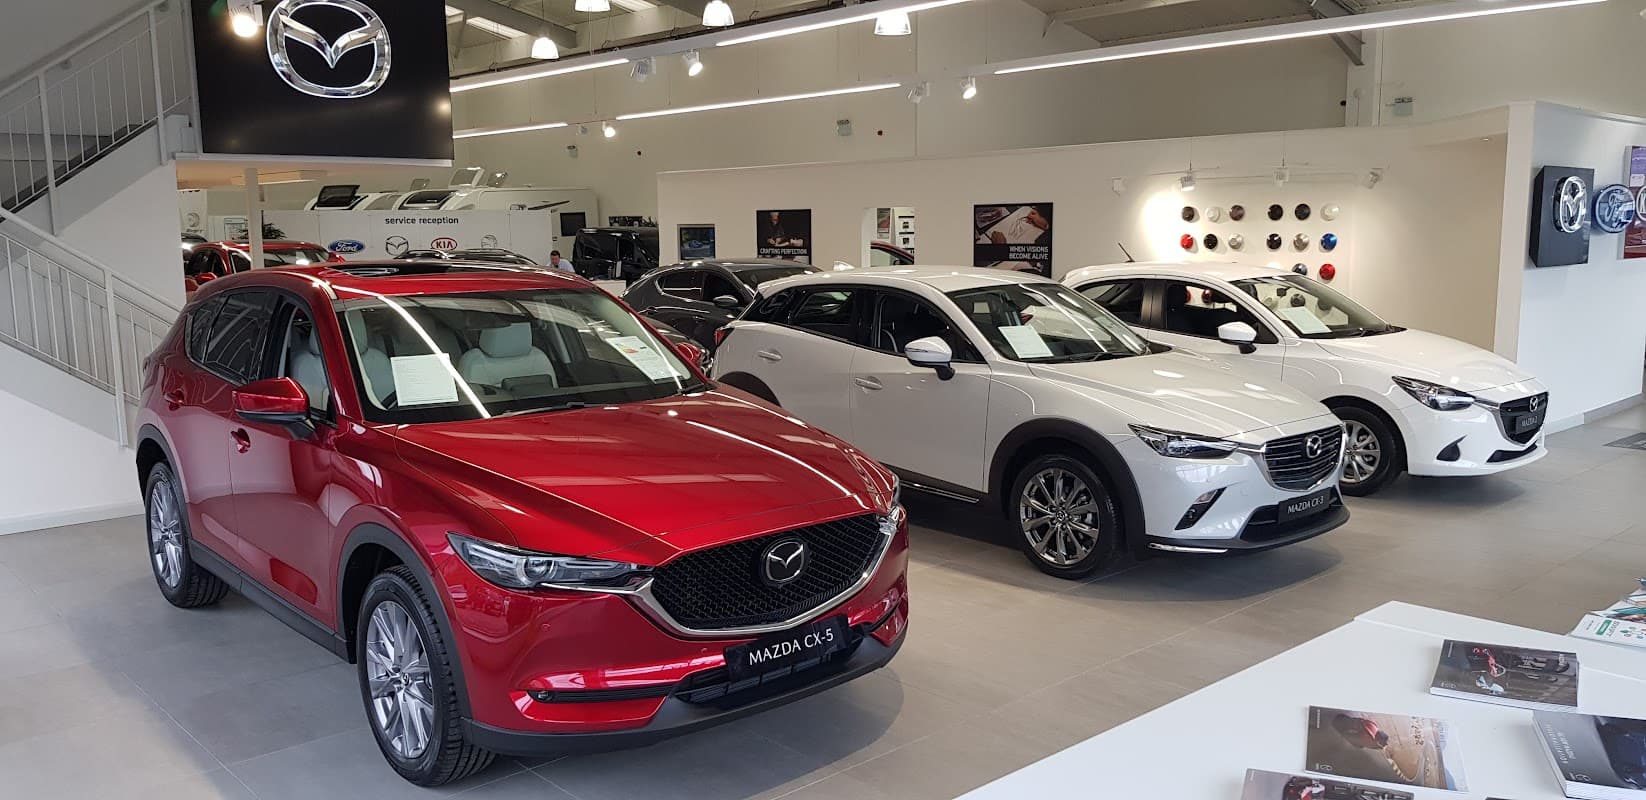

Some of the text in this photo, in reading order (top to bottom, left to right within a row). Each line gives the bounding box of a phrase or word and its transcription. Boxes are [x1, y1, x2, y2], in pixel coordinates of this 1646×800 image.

[384, 216, 459, 226] service reception
[1287, 495, 1324, 514] MAZDA CX-3
[749, 628, 834, 665] MAZDA CX-5
